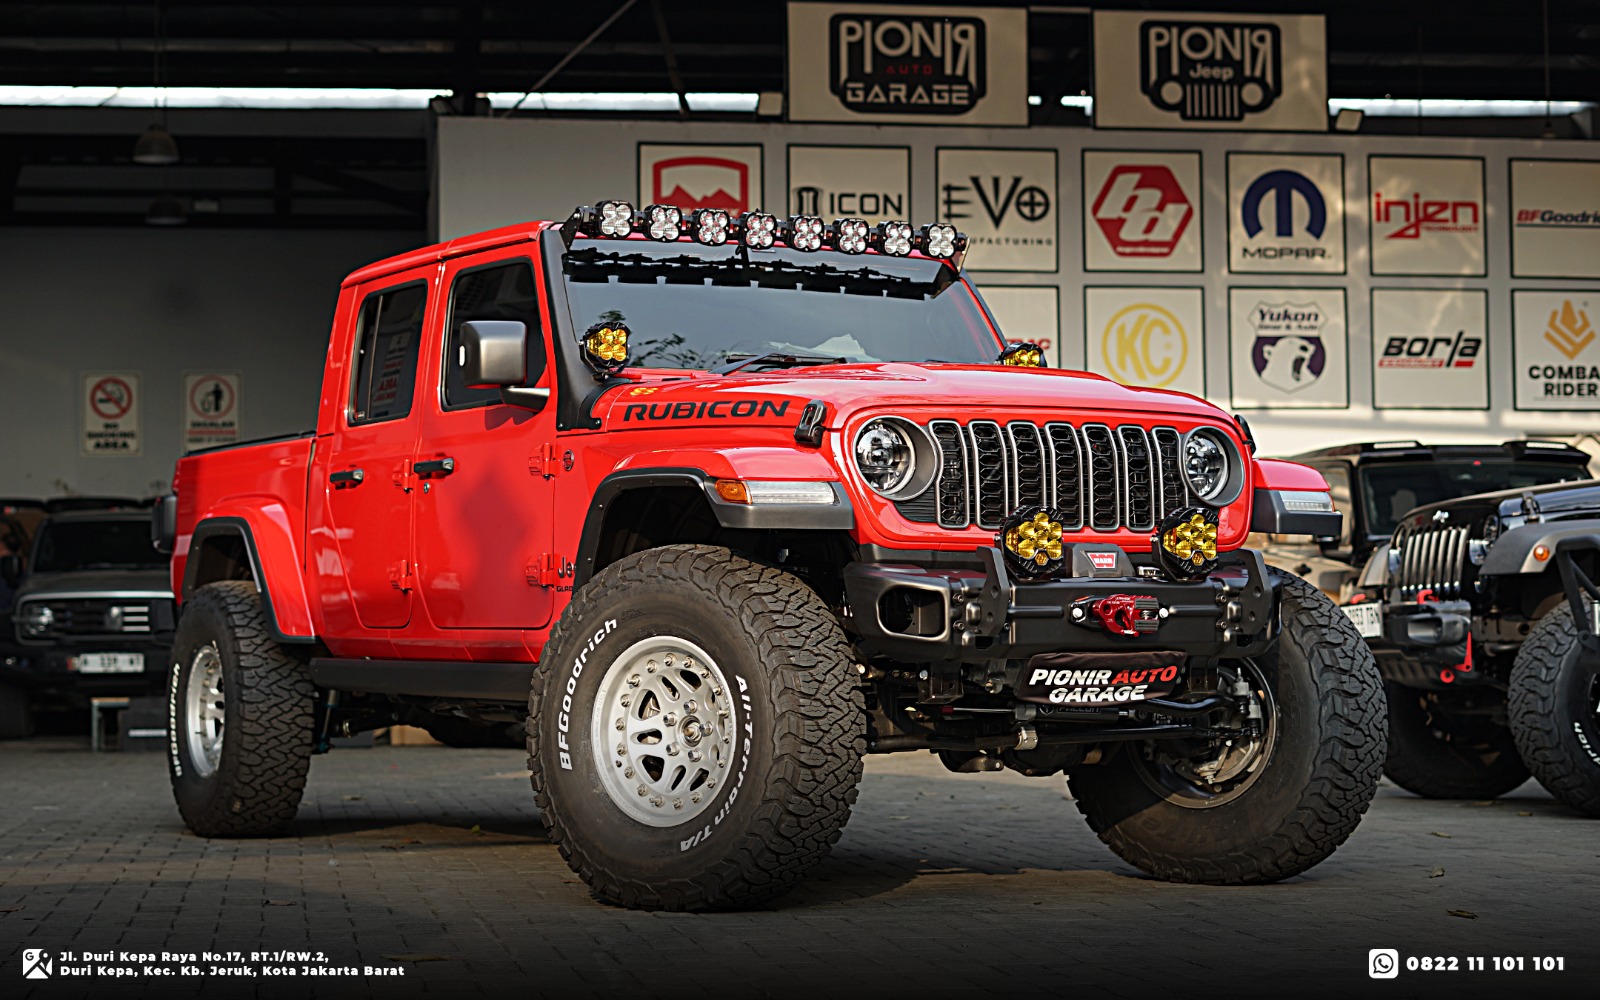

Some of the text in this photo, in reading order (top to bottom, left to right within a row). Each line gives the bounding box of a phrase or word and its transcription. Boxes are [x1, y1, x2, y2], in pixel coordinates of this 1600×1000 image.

[885, 63, 933, 75] AUTO
[1189, 62, 1234, 82] Jeep
[845, 82, 970, 105] GARAGE
[829, 193, 902, 216] ICON
[1517, 209, 1600, 223] BFGoodri
[970, 237, 1053, 246] UFACTURING
[1259, 308, 1319, 322] Yukon
[1115, 313, 1171, 381] KC
[1529, 365, 1600, 379] COMBA
[1544, 383, 1598, 396] RIDER
[623, 400, 791, 421] RUBICON
[1029, 665, 1178, 686] PIONIR AUTO
[558, 618, 617, 771] BFGoodrich
[1049, 684, 1149, 704] GARAGE
[680, 675, 753, 852] All-Terrain T/A
